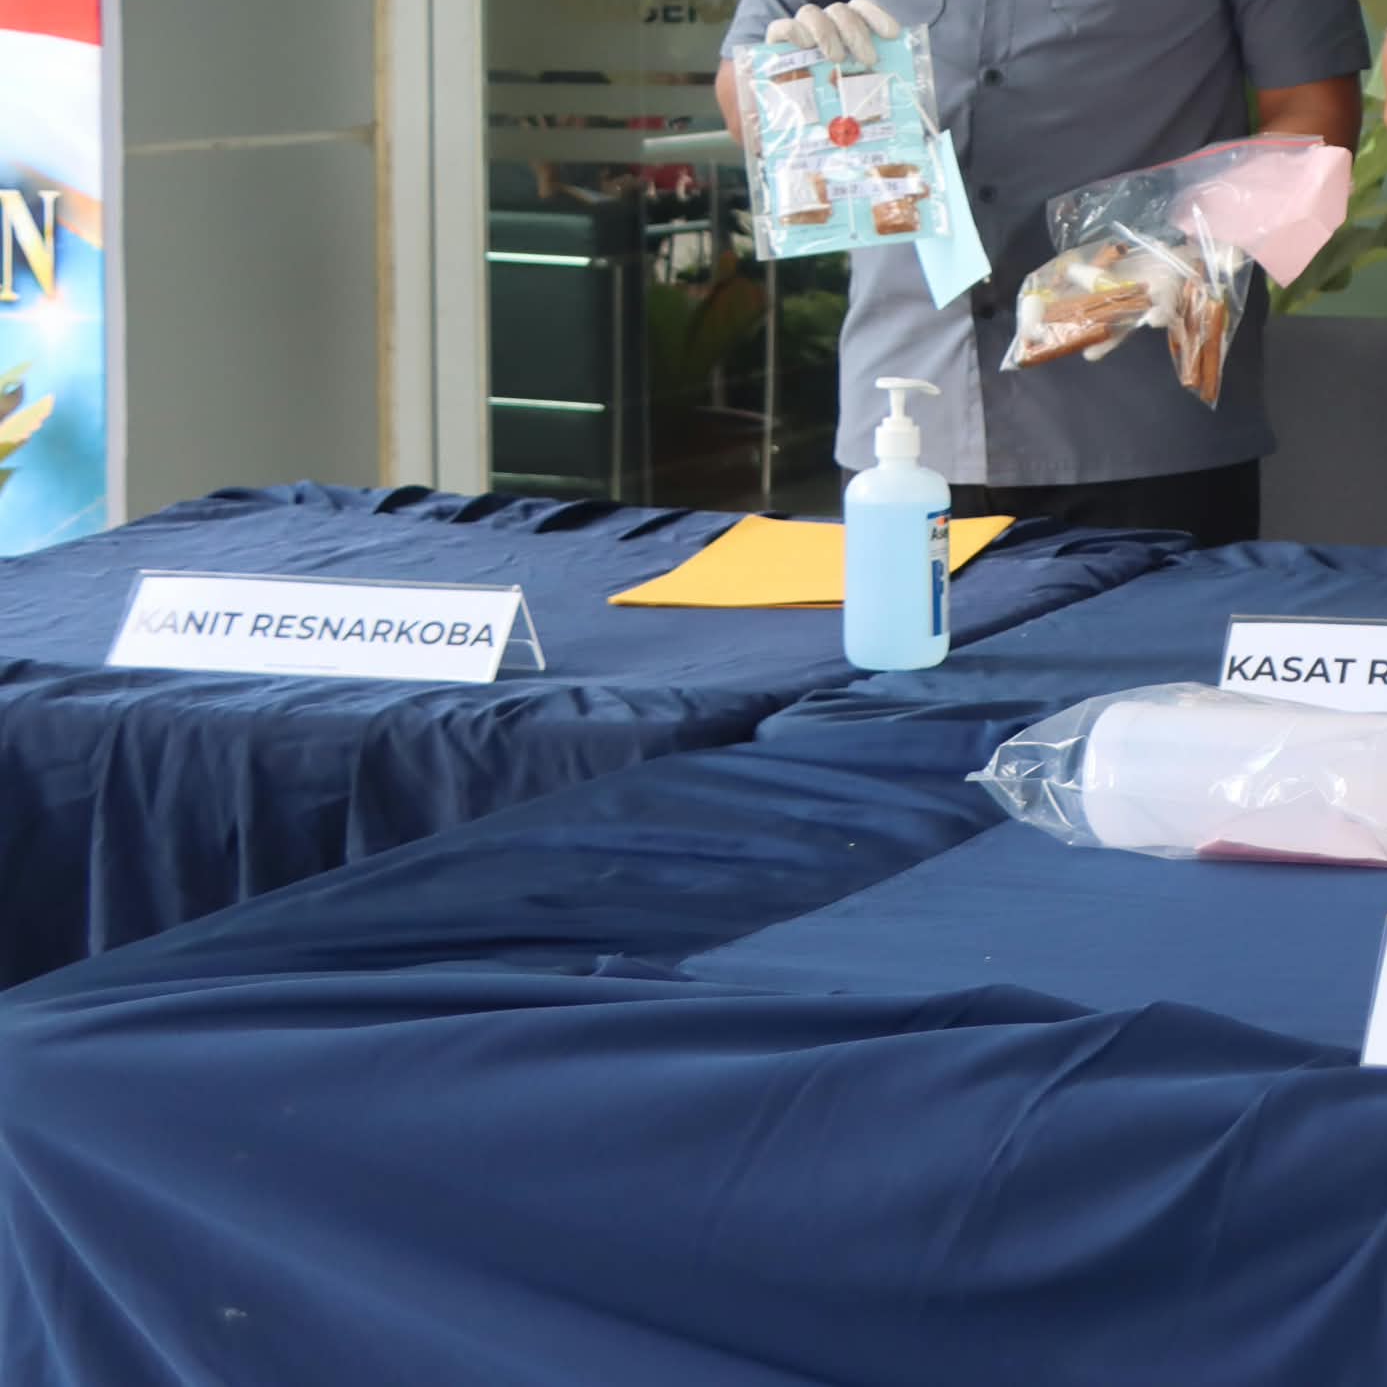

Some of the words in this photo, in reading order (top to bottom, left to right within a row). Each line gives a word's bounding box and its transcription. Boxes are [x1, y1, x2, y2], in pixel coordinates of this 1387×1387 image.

[137, 610, 242, 636] KANIT
[249, 613, 495, 648] RESNARKOBA
[1226, 655, 1356, 684] KASAT
